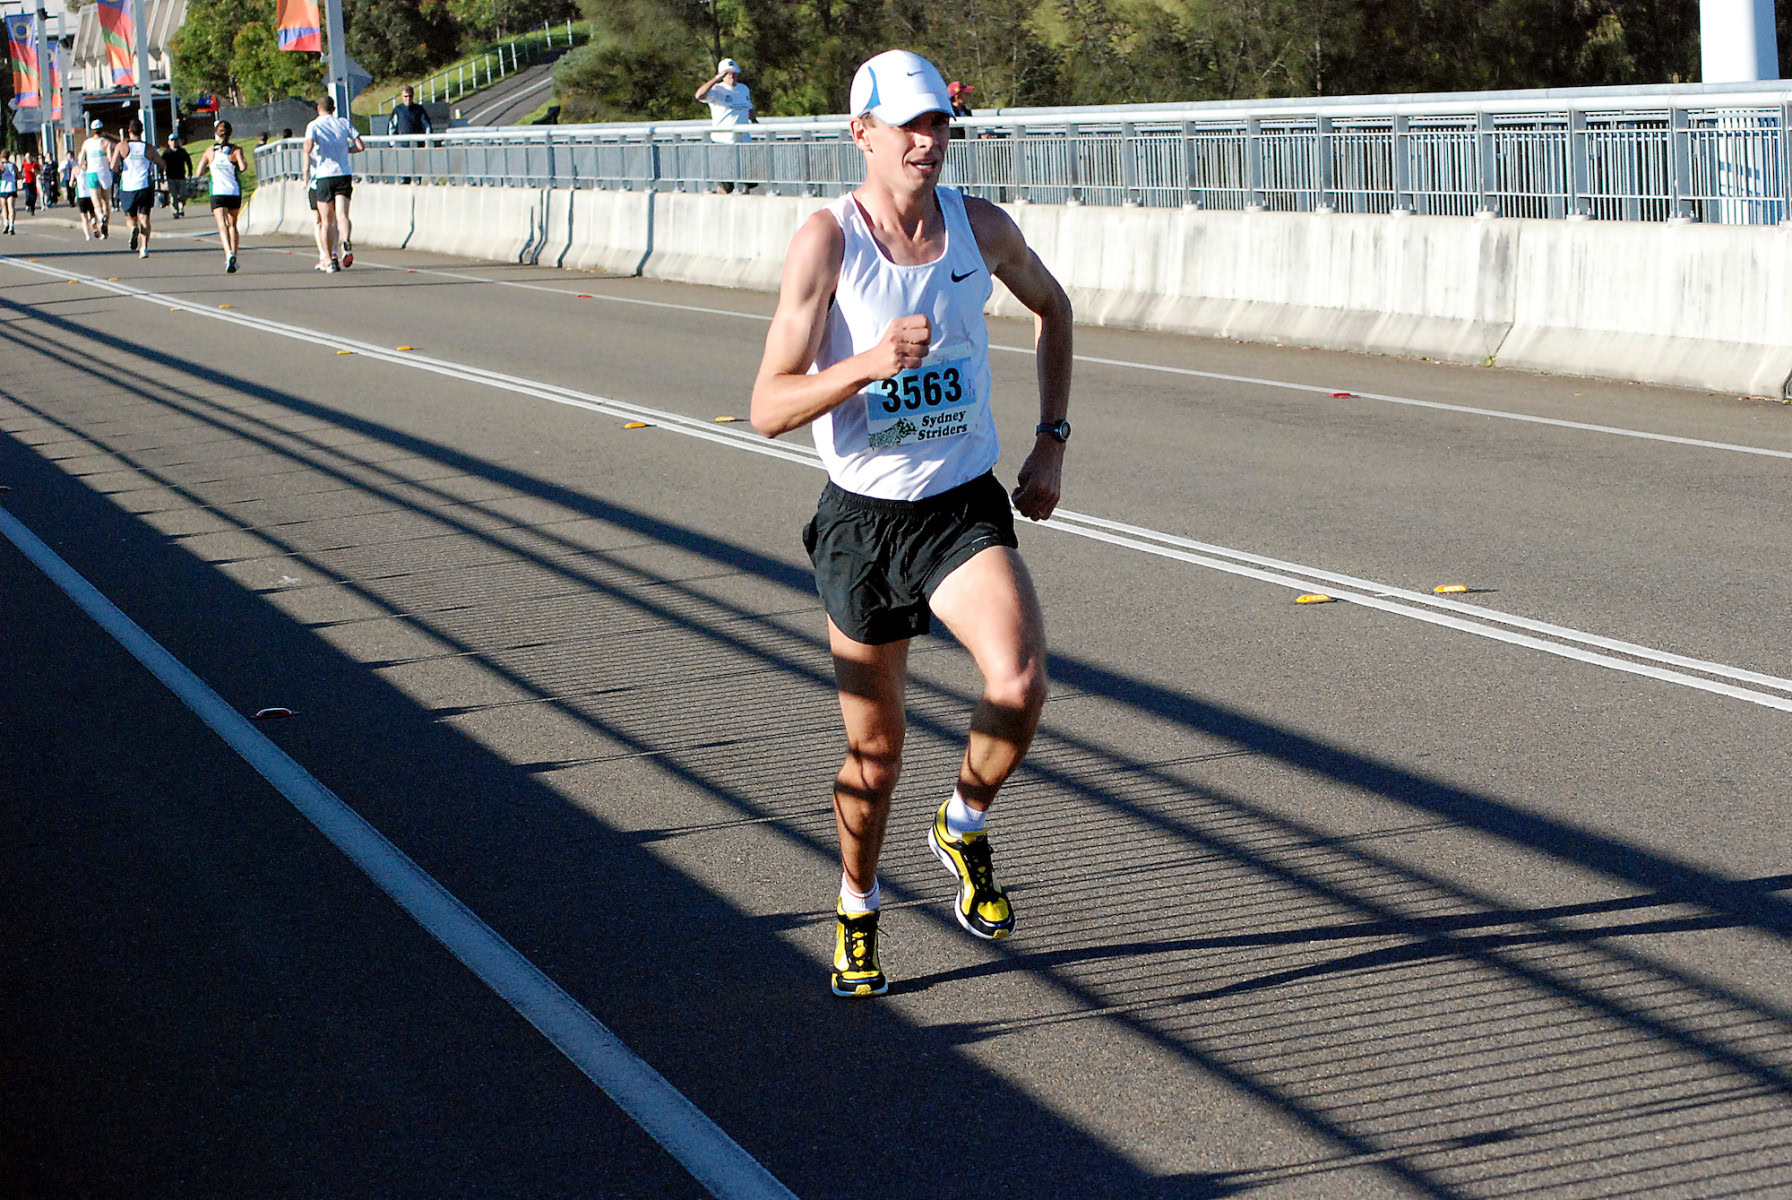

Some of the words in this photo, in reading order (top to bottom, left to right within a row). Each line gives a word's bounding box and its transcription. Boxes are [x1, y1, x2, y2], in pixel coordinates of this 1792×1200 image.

[881, 367, 962, 413] 3563
[922, 410, 966, 428] Sydney
[918, 423, 967, 440] Striders
